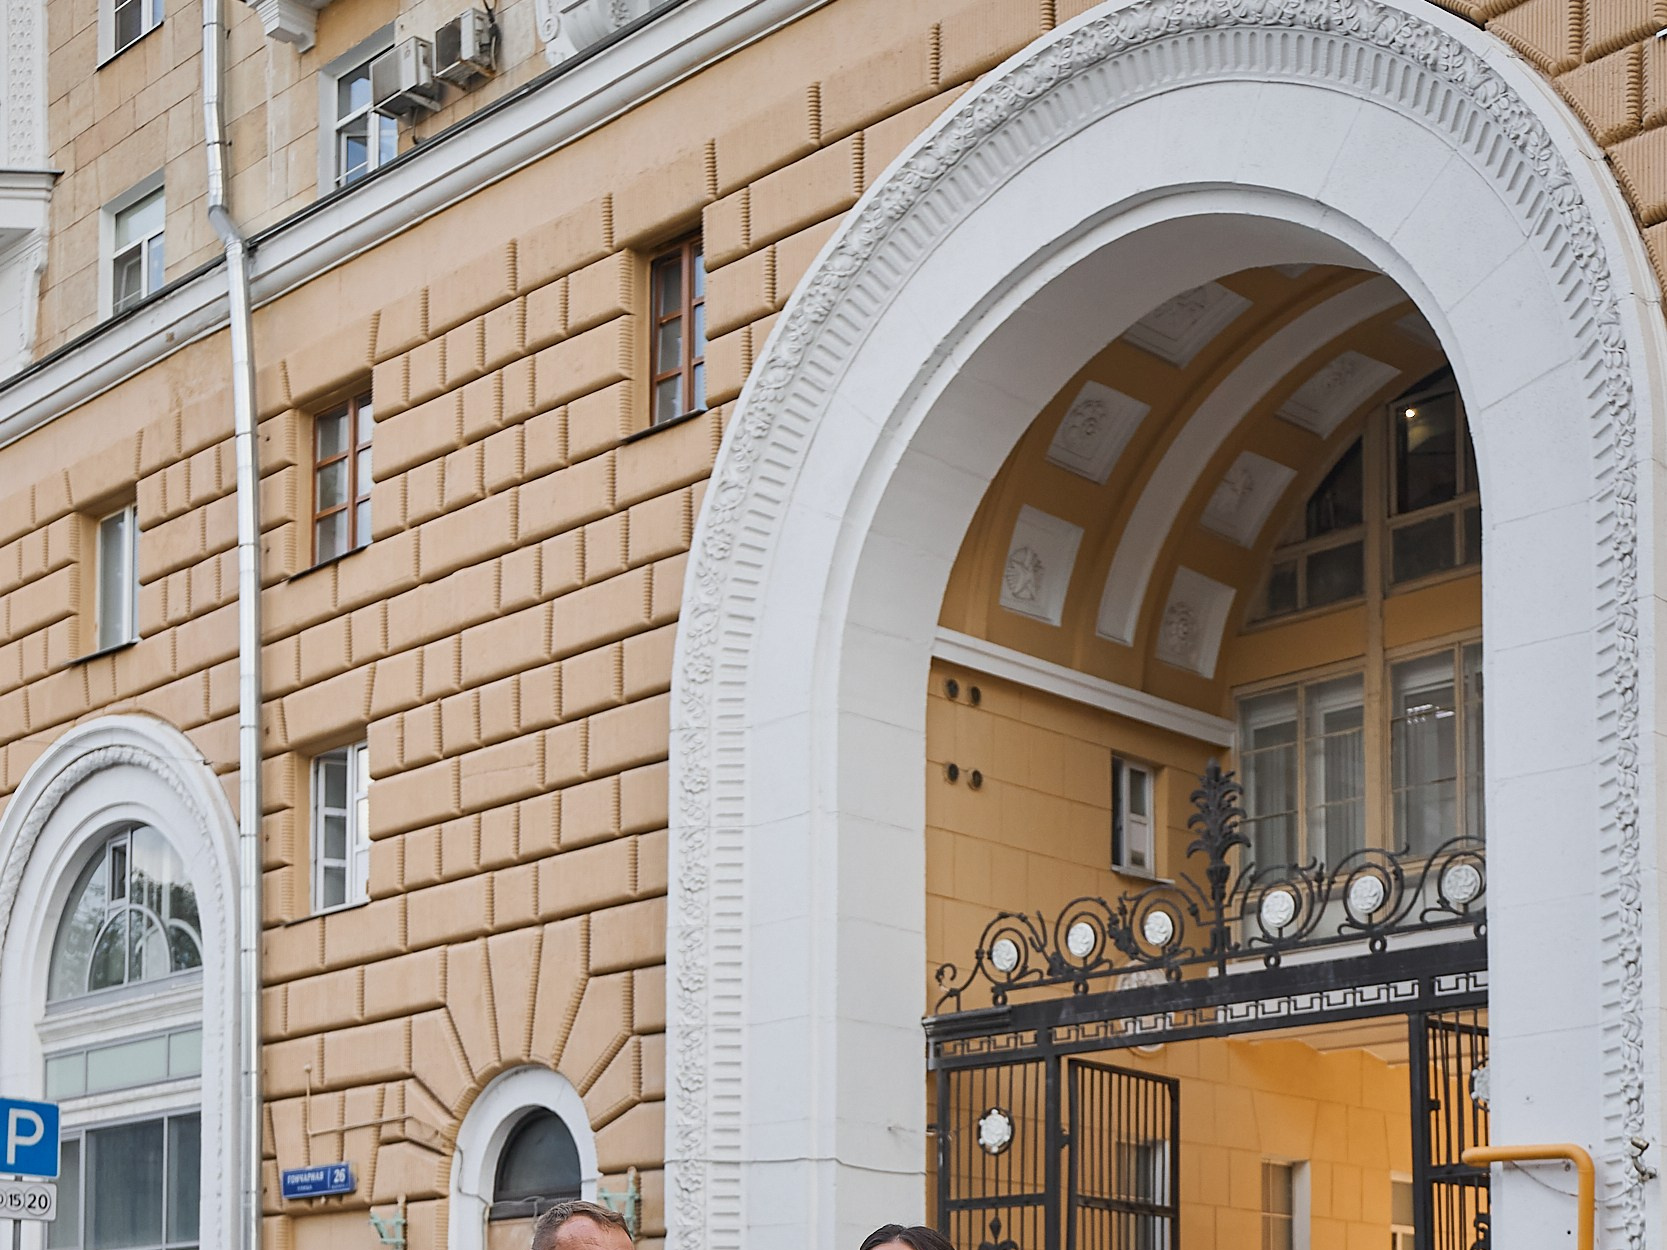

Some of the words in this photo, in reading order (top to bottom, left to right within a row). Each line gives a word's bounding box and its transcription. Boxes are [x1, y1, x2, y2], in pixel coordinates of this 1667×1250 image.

[6, 1107, 45, 1165] P
[287, 1171, 324, 1184] ГОНЧАРНАЯ
[333, 1168, 346, 1184] 26
[10, 1193, 21, 1207] 15
[27, 1193, 48, 1209] 20
